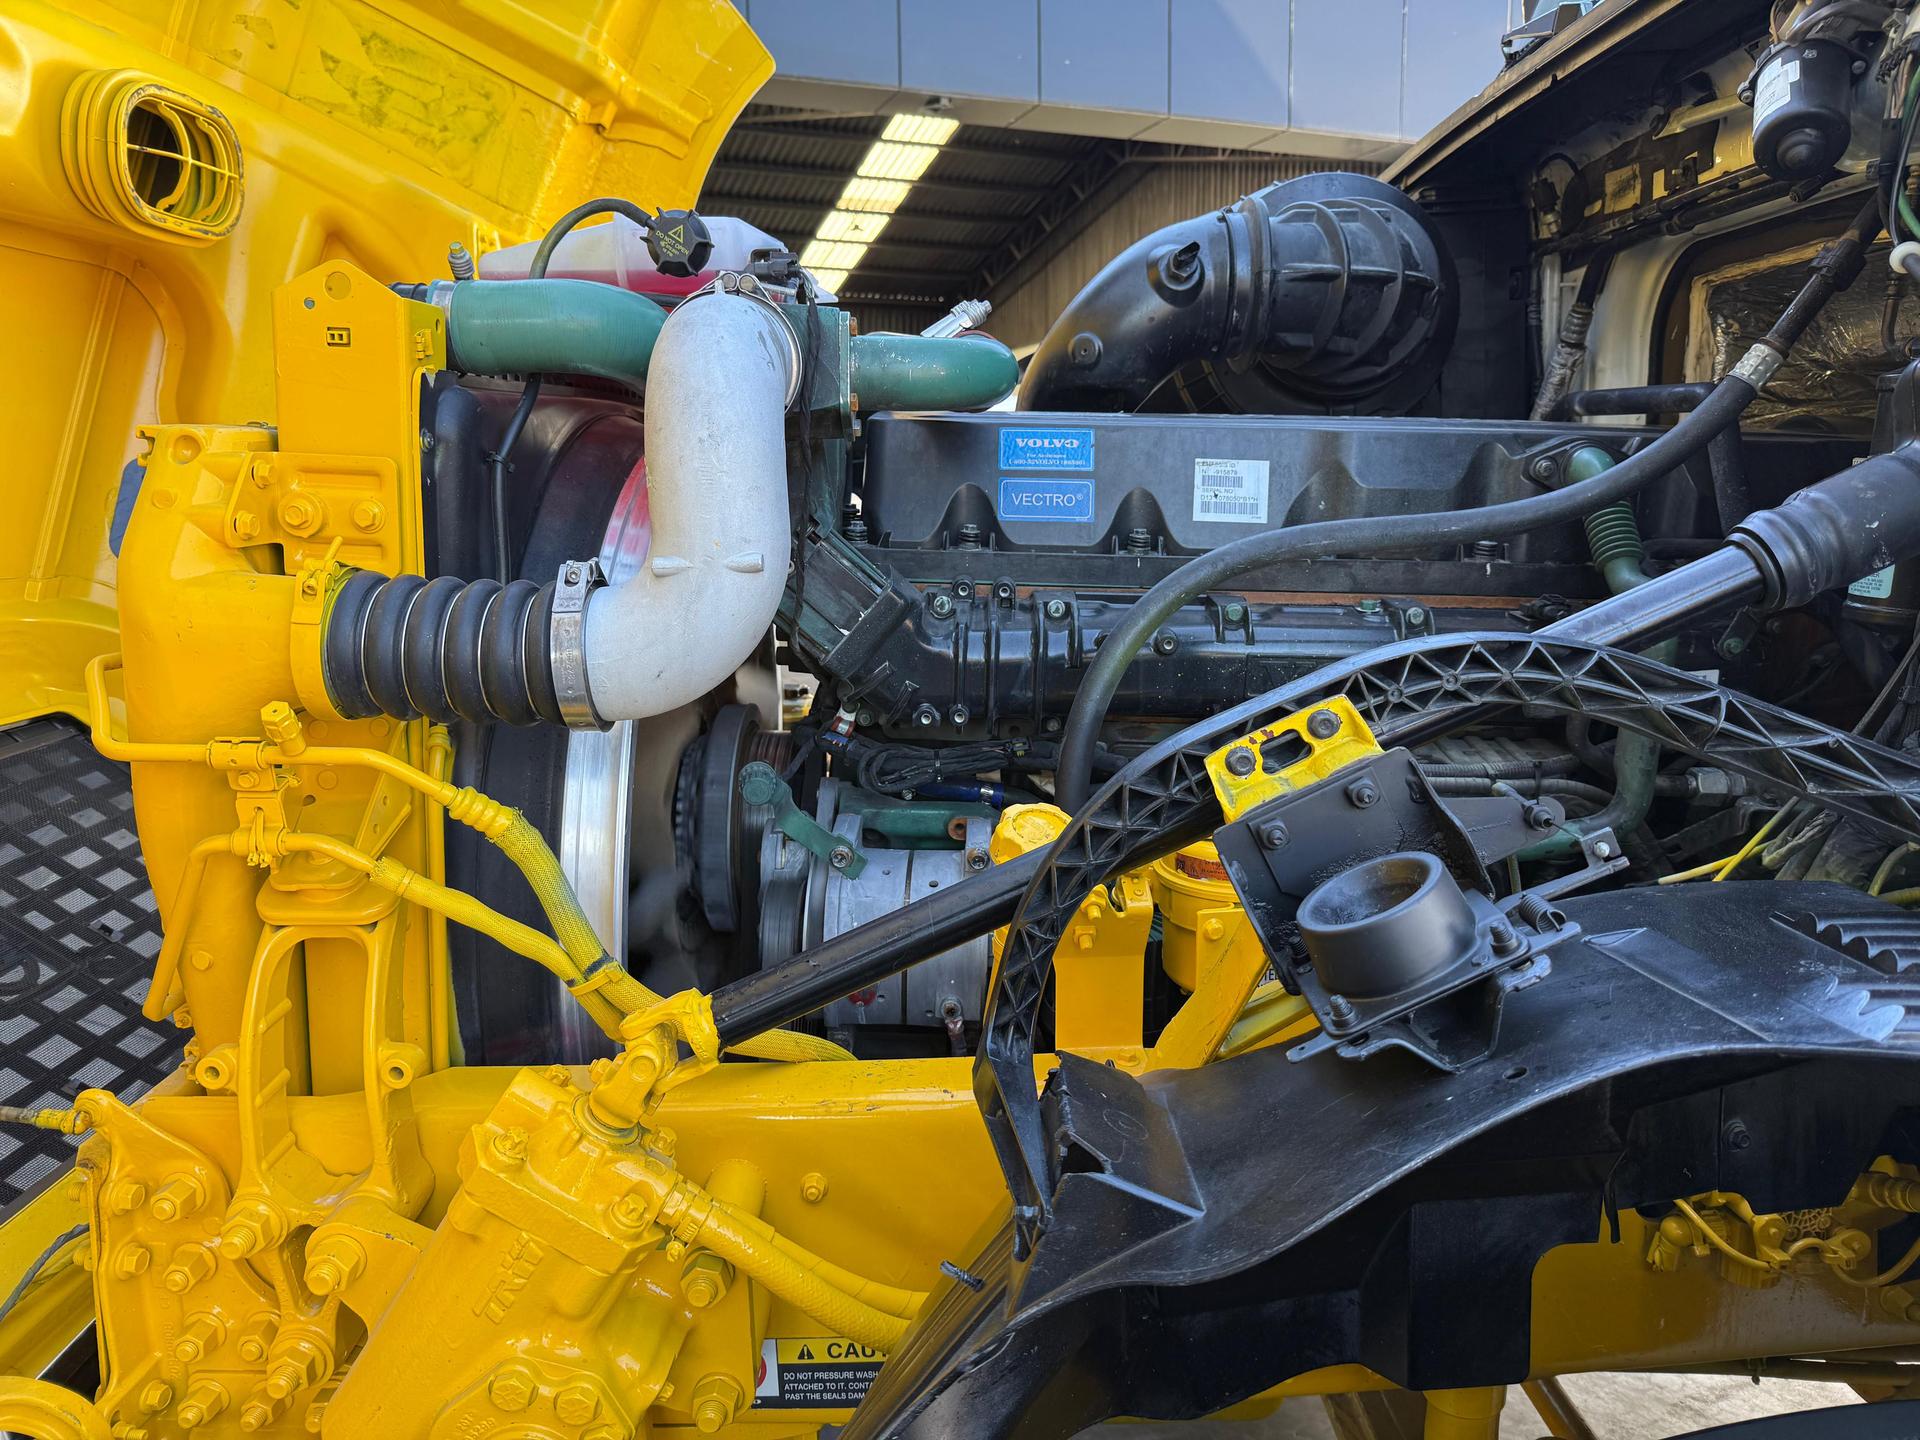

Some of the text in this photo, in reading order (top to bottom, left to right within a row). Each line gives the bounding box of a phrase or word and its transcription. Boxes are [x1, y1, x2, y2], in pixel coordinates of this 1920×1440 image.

[664, 235, 675, 246] NOT
[675, 243, 689, 255] OPEN
[1015, 438, 1080, 448] VOLVO
[827, 1342, 887, 1359] CAU
[784, 1372, 795, 1380] DO
[797, 1372, 812, 1380] NOT
[814, 1371, 854, 1380] PRESSURE
[784, 1383, 824, 1391] ATTACHED
[826, 1382, 836, 1390] TO
[837, 1382, 847, 1390] IT.
[785, 1393, 804, 1401] PAST
[822, 1392, 846, 1400] SEALS
